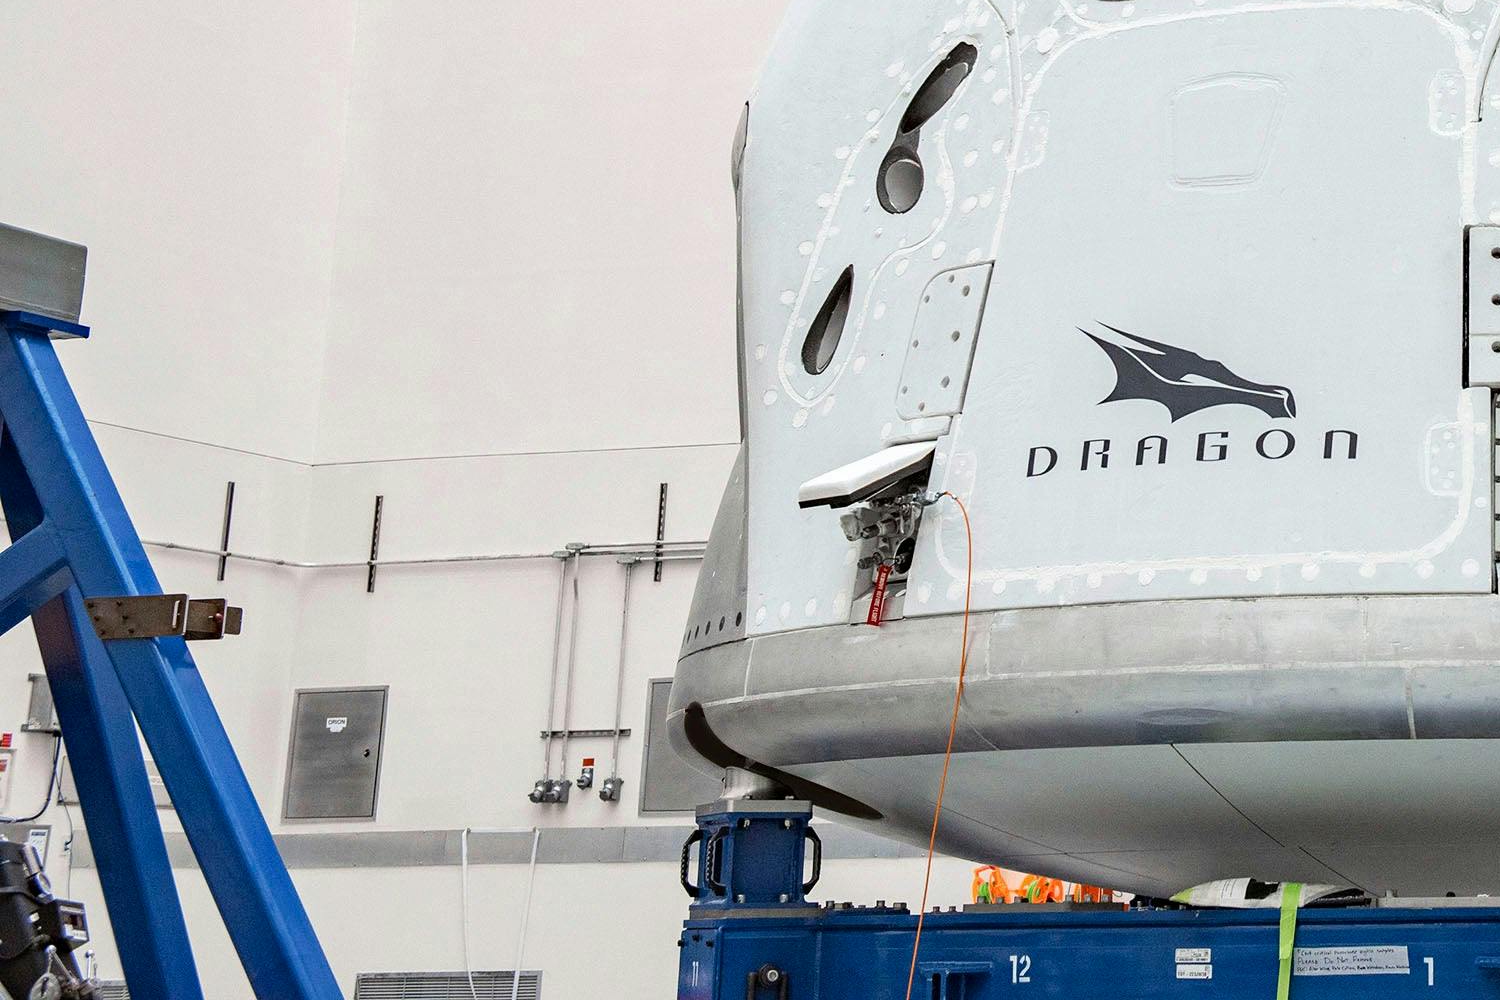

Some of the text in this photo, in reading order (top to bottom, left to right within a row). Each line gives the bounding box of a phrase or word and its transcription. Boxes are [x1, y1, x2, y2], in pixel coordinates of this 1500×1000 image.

[1026, 429, 1358, 477] DRAGON
[691, 961, 699, 987] 11
[1009, 955, 1031, 984] 12
[1423, 957, 1434, 986] 1
